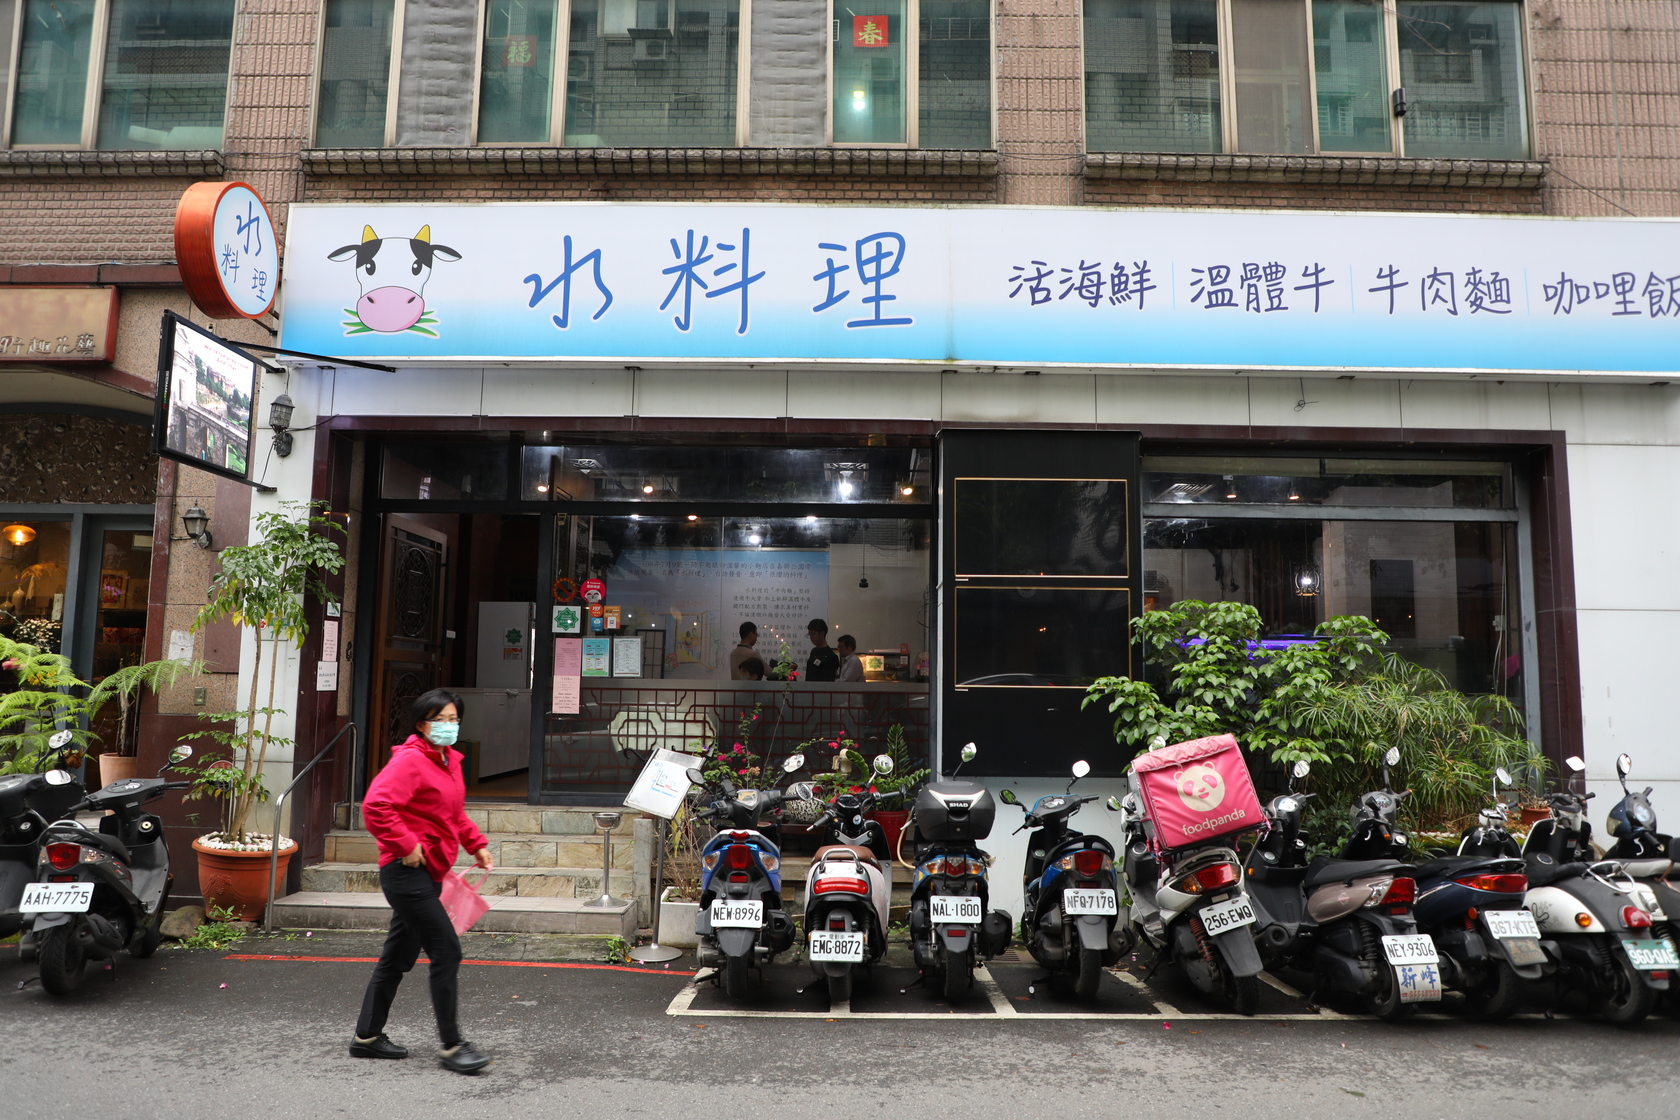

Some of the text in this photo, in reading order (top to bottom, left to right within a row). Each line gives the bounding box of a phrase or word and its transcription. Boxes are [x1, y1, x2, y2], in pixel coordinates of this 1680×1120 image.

[857, 20, 883, 46] 春
[508, 40, 532, 66] 福
[523, 226, 914, 336] 水料理
[1007, 259, 1680, 319] 活海鮮 溫體牛 牛肉麵 咖哩飯
[1182, 808, 1246, 836] foodpanda
[1401, 965, 1437, 990] 新峰
